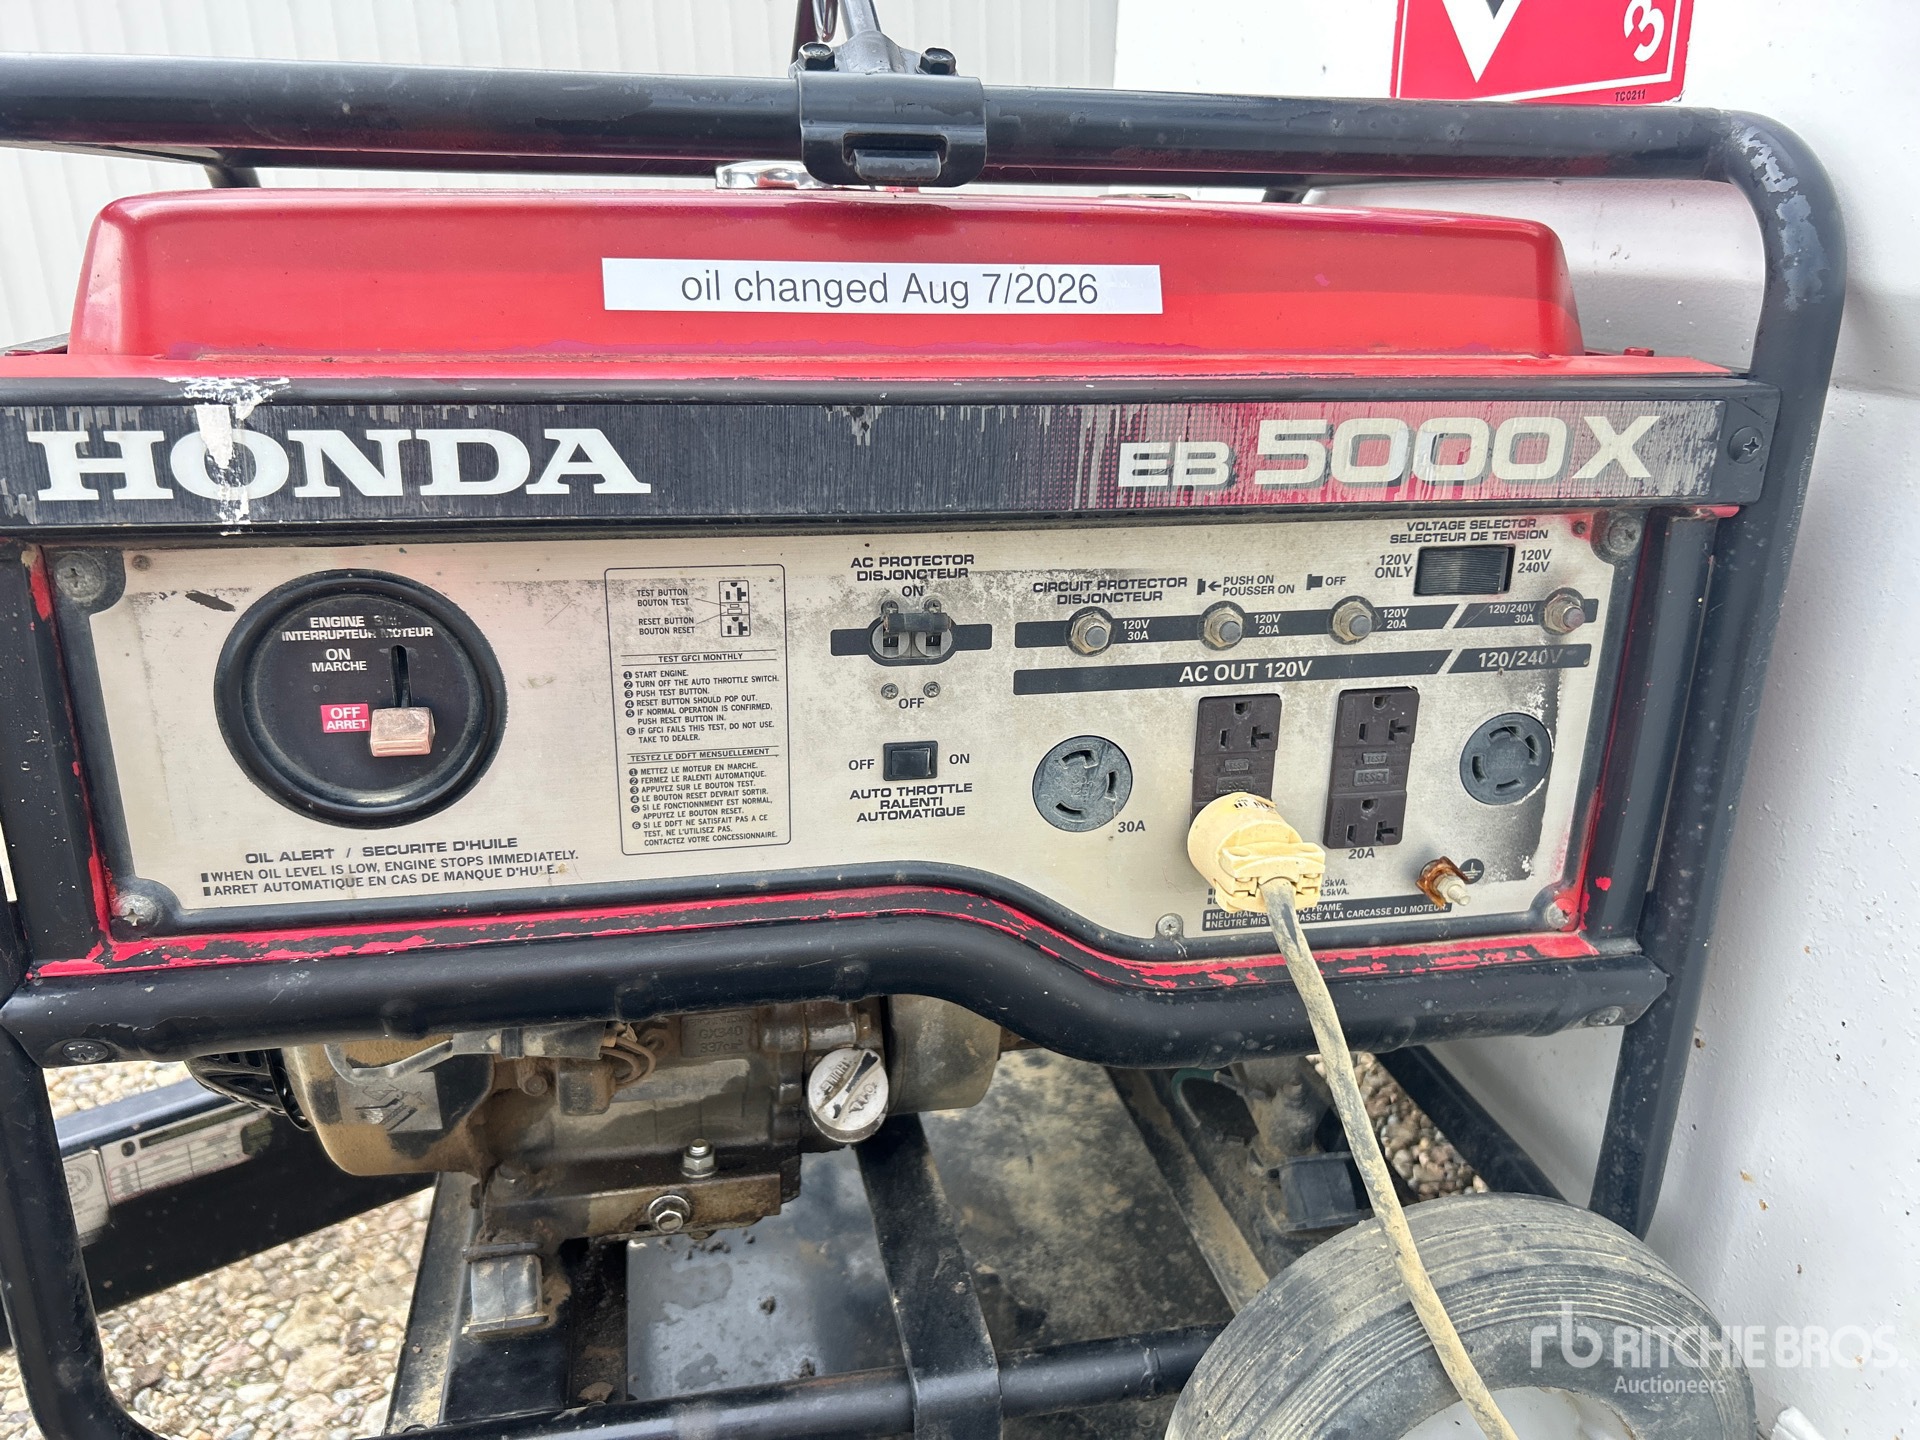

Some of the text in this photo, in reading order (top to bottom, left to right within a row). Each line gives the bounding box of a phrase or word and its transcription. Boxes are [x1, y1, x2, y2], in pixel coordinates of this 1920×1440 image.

[1615, 89, 1646, 101] TC0211
[681, 270, 1098, 309] oil changed Aug 7/2026
[1118, 415, 1661, 488] EB 5000X
[26, 428, 651, 501] HONDA
[1407, 519, 1536, 531] VOLTAGE SELECTOR
[1390, 530, 1548, 543] SELECTEUR DE TENSION
[1379, 554, 1412, 565] 120V
[1521, 549, 1551, 560] 120V
[851, 555, 974, 568] AC PROTECTOR
[1518, 562, 1549, 573] 240V
[857, 568, 968, 581] DISJONCTEUR
[1374, 566, 1413, 578] ONLY
[1033, 577, 1187, 592] CIRCUIT PROTECTOR
[1223, 575, 1274, 585] PUSH ON
[1326, 576, 1346, 586] OFF
[902, 586, 923, 597] ON
[1223, 585, 1294, 596] POUSSER ON
[1057, 591, 1162, 604] DISJONCTEUR
[1383, 608, 1409, 618] 120V
[1489, 604, 1535, 614] 120/240V
[310, 616, 364, 628] ENGINE
[1123, 619, 1150, 629] 120V
[1254, 614, 1281, 624] 120V
[1387, 620, 1407, 629] 20A
[1514, 614, 1534, 623] 30A
[282, 628, 376, 641] INTERRUPTEUR
[1128, 631, 1149, 640] 30A
[1259, 625, 1279, 634] 20A
[326, 648, 351, 661] ON
[703, 653, 742, 661] MONTHLY
[1479, 648, 1563, 667] 120/240V
[312, 661, 367, 672] MARCHE
[1179, 660, 1312, 682] AC OUT 120V
[752, 675, 779, 683] SWITCH.
[679, 706, 718, 714] OPERATION
[732, 703, 772, 712] CONFIRMED,
[899, 698, 924, 708] OFF
[330, 707, 360, 719] OFF
[326, 720, 367, 730] ARRET
[672, 734, 700, 742] DEALER.
[631, 754, 661, 762] TESTEZ
[700, 749, 769, 758] MENSUELLEMENT
[950, 754, 969, 764] ON
[849, 759, 874, 770] OFF
[1357, 771, 1388, 784] RESET
[850, 783, 972, 799] AUTO THROTTLE
[880, 797, 942, 809] RALENTI
[857, 806, 965, 822] AUTOMATIQUE
[1118, 820, 1145, 833] 30A
[245, 852, 273, 864] OIL
[280, 848, 334, 862] ALERT
[363, 842, 447, 857] SECURITE
[453, 838, 517, 851] D'HUILE
[1348, 848, 1375, 859] 20A
[211, 850, 579, 882] WHEN OIL LEVEL IS LOW, ENGINE STOPS IMMEDIATELY.
[214, 884, 258, 896] ARRET
[264, 877, 364, 892] AUTOMATIQUE
[369, 876, 386, 886] EN
[391, 874, 417, 884] CAS
[422, 872, 439, 883] DE
[444, 868, 501, 881] MANQUE
[1312, 903, 1343, 912] FRAME.
[1211, 919, 1247, 928] NEUTRE
[1251, 918, 1266, 926] MIS
[1347, 908, 1391, 918] CARCASSE
